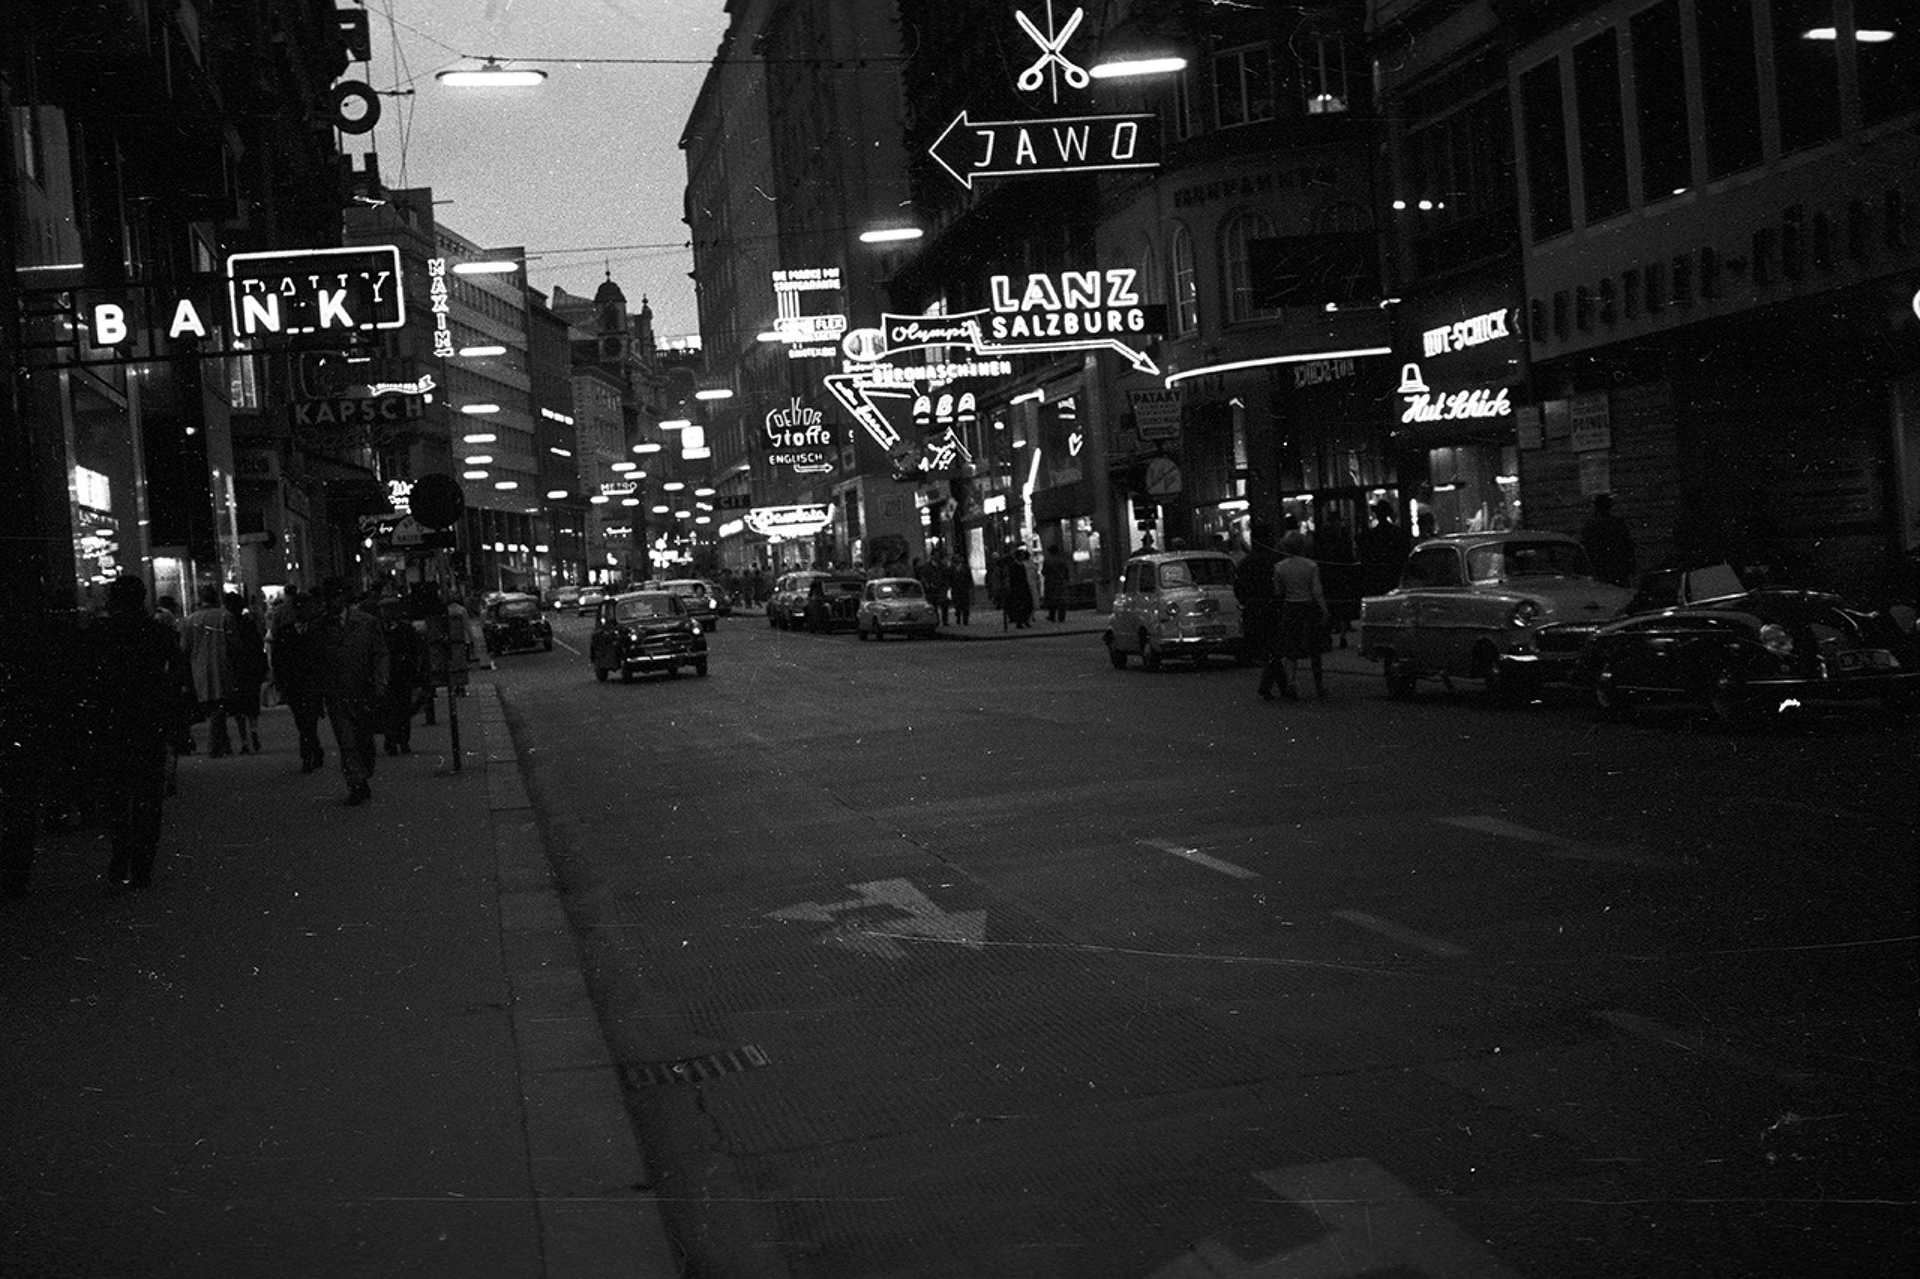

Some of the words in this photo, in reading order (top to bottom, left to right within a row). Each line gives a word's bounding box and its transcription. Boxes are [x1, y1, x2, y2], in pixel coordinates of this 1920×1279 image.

[973, 121, 1138, 168] JAWO
[427, 258, 452, 348] MAXIM
[989, 267, 1139, 313] LANZ
[94, 288, 356, 346] BANK
[991, 308, 1145, 340] SALZBURG
[294, 397, 424, 425] KAPSCH
[1401, 393, 1443, 422] Hut
[1444, 387, 1511, 419] Schick
[768, 452, 823, 466] ENGLISCH
